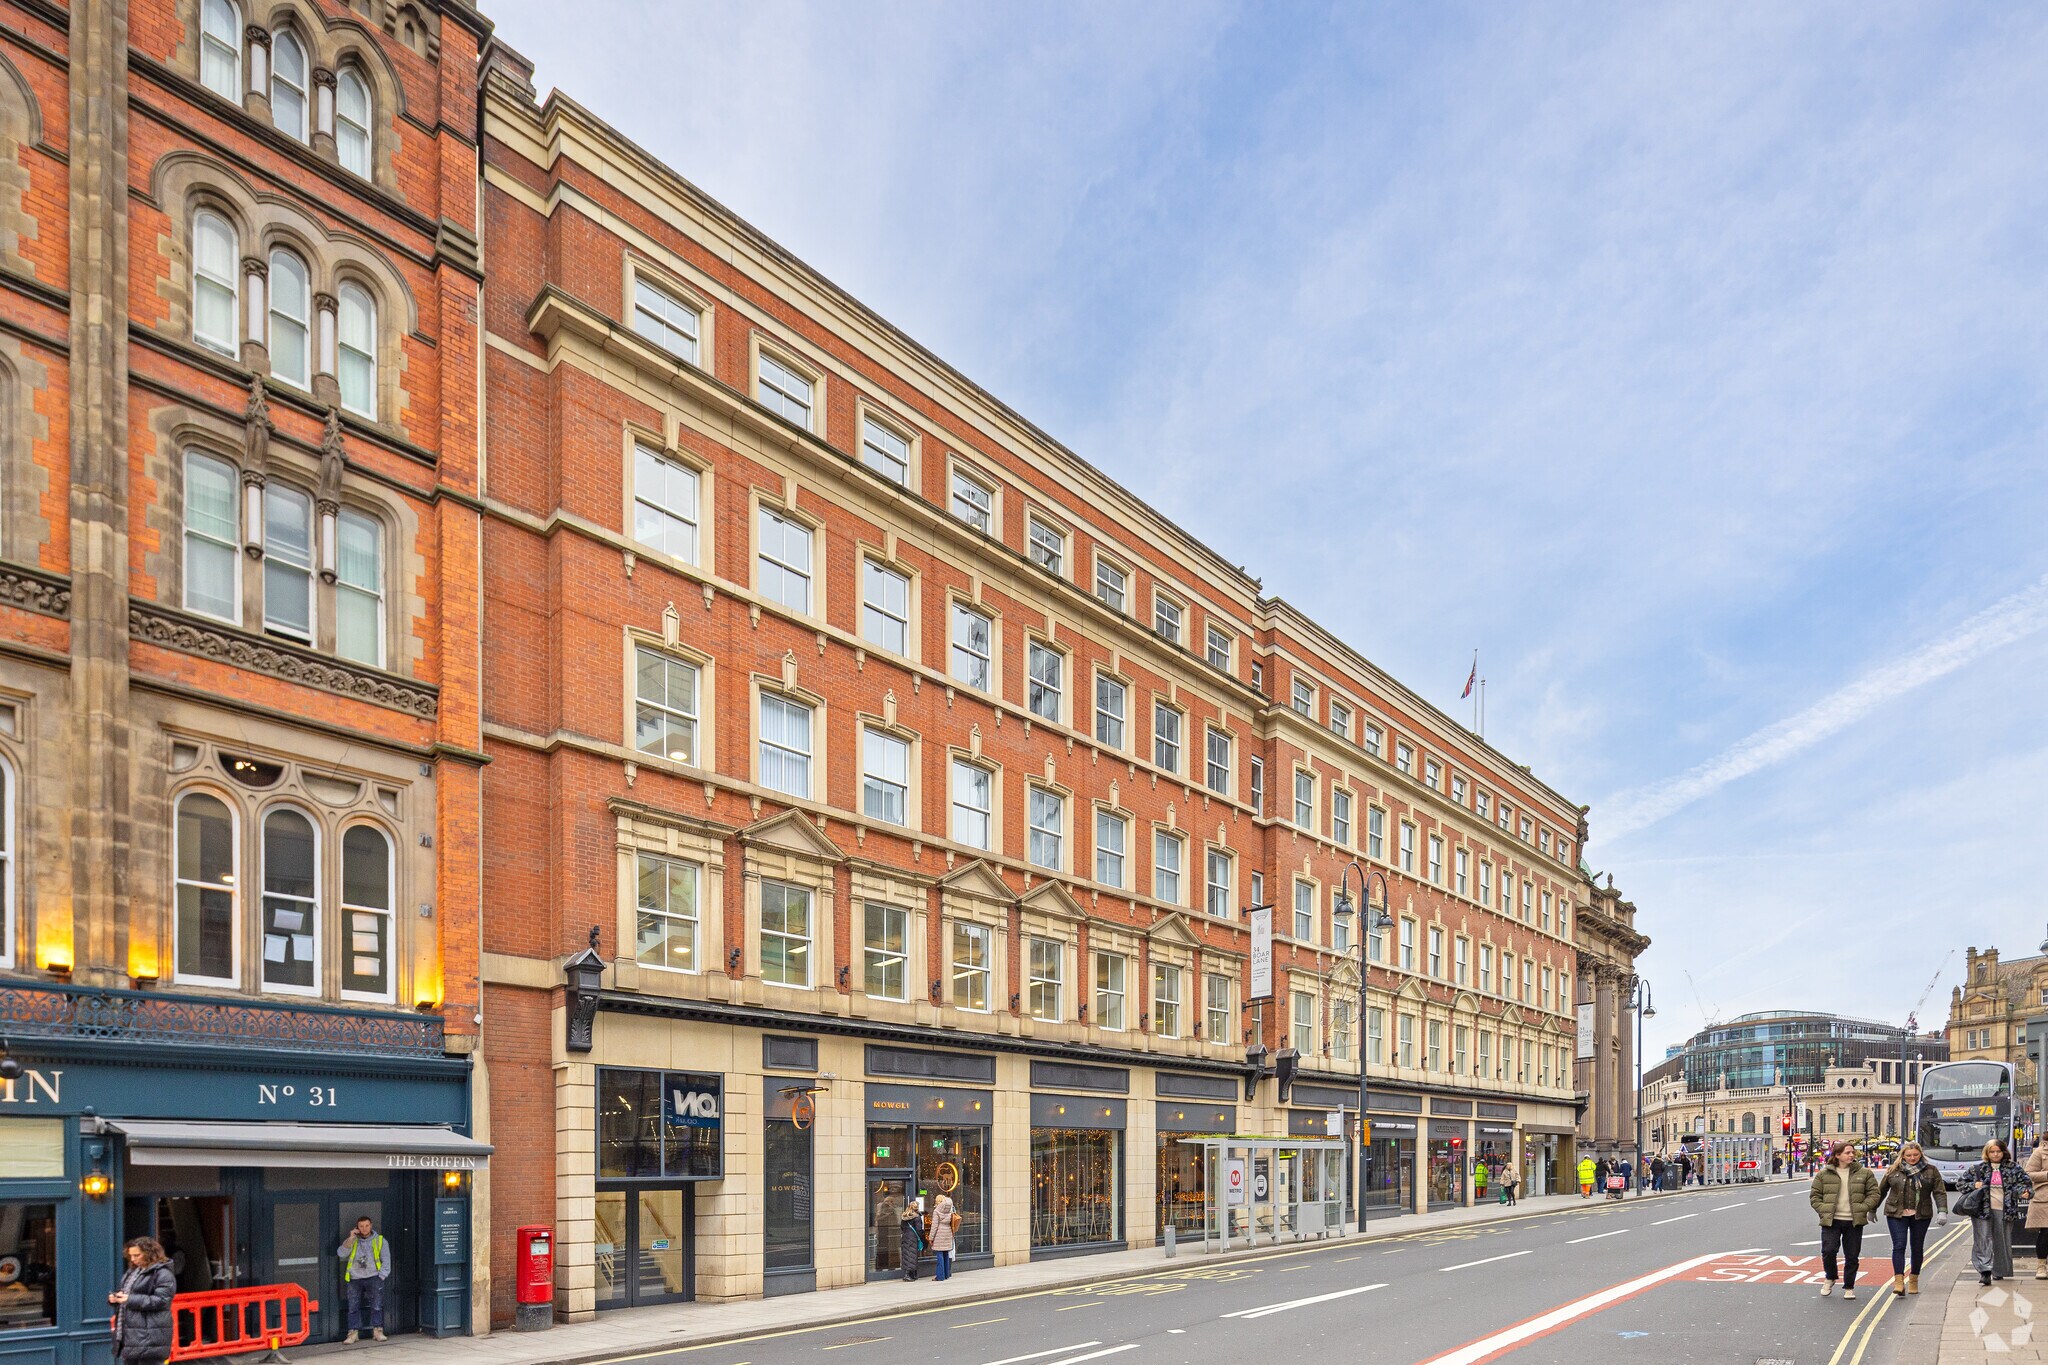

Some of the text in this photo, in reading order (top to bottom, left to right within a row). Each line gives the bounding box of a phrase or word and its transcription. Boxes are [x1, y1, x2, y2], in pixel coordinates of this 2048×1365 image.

[1253, 951, 1270, 959] BOAR
[1253, 957, 1269, 965] LANE
[309, 1086, 337, 1106] 31
[873, 1101, 909, 1109] MOWGLI
[1978, 1105, 1994, 1116] 7A
[385, 1155, 475, 1168] THE GRIFFIN
[1696, 1268, 1868, 1285] BUS
